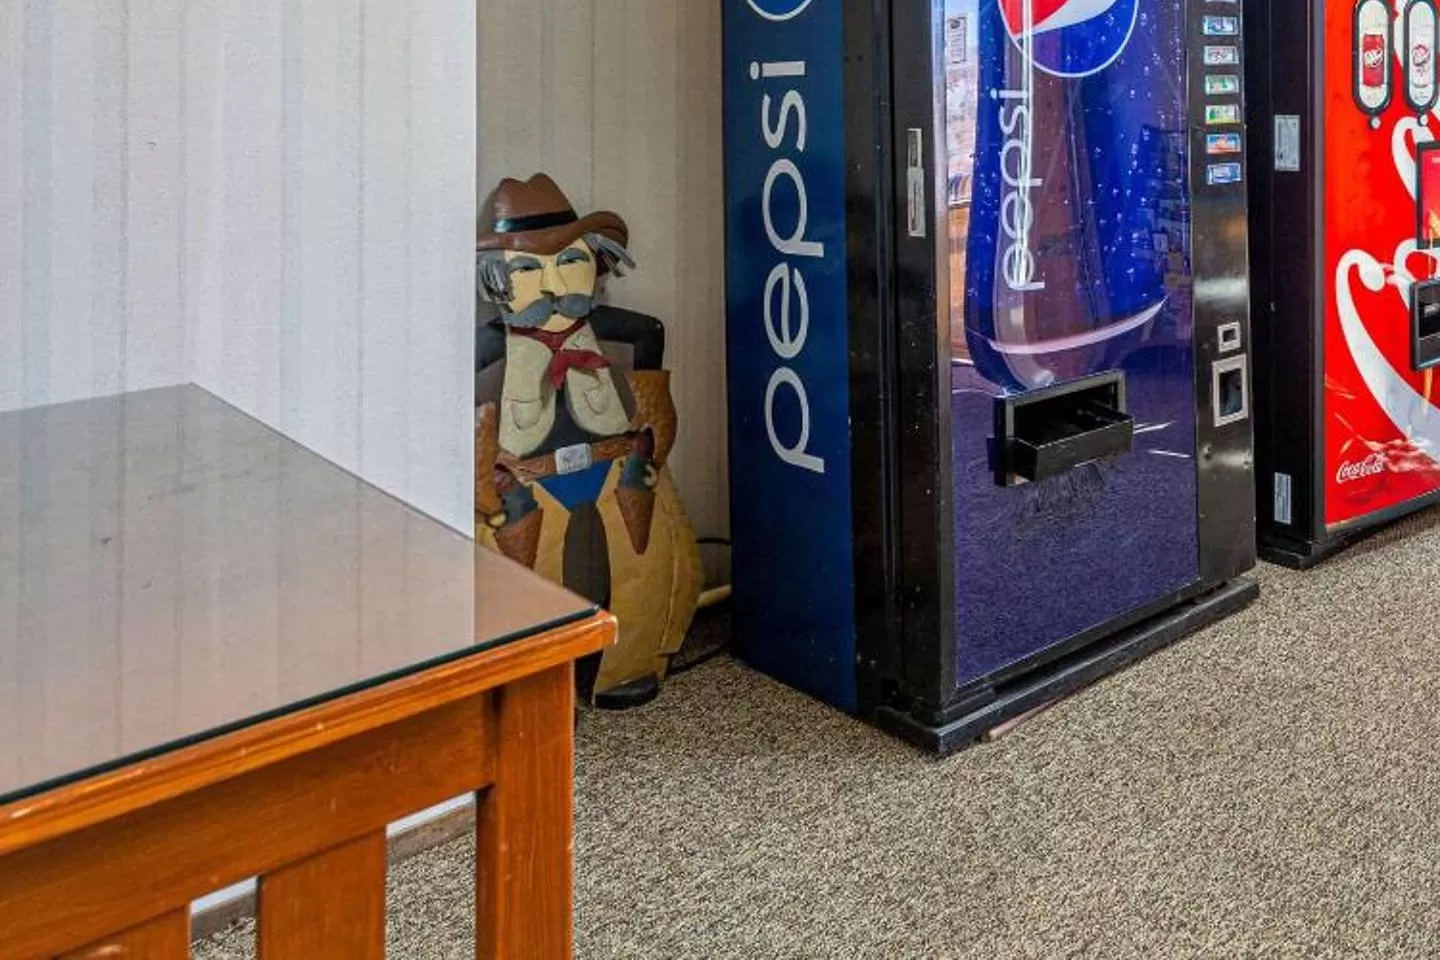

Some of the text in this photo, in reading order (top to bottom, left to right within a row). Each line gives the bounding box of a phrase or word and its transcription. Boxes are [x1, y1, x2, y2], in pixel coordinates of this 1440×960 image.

[750, 60, 825, 474] pepsi
[990, 87, 1046, 292] pepsi
[1336, 450, 1386, 484] Coca-Cola
